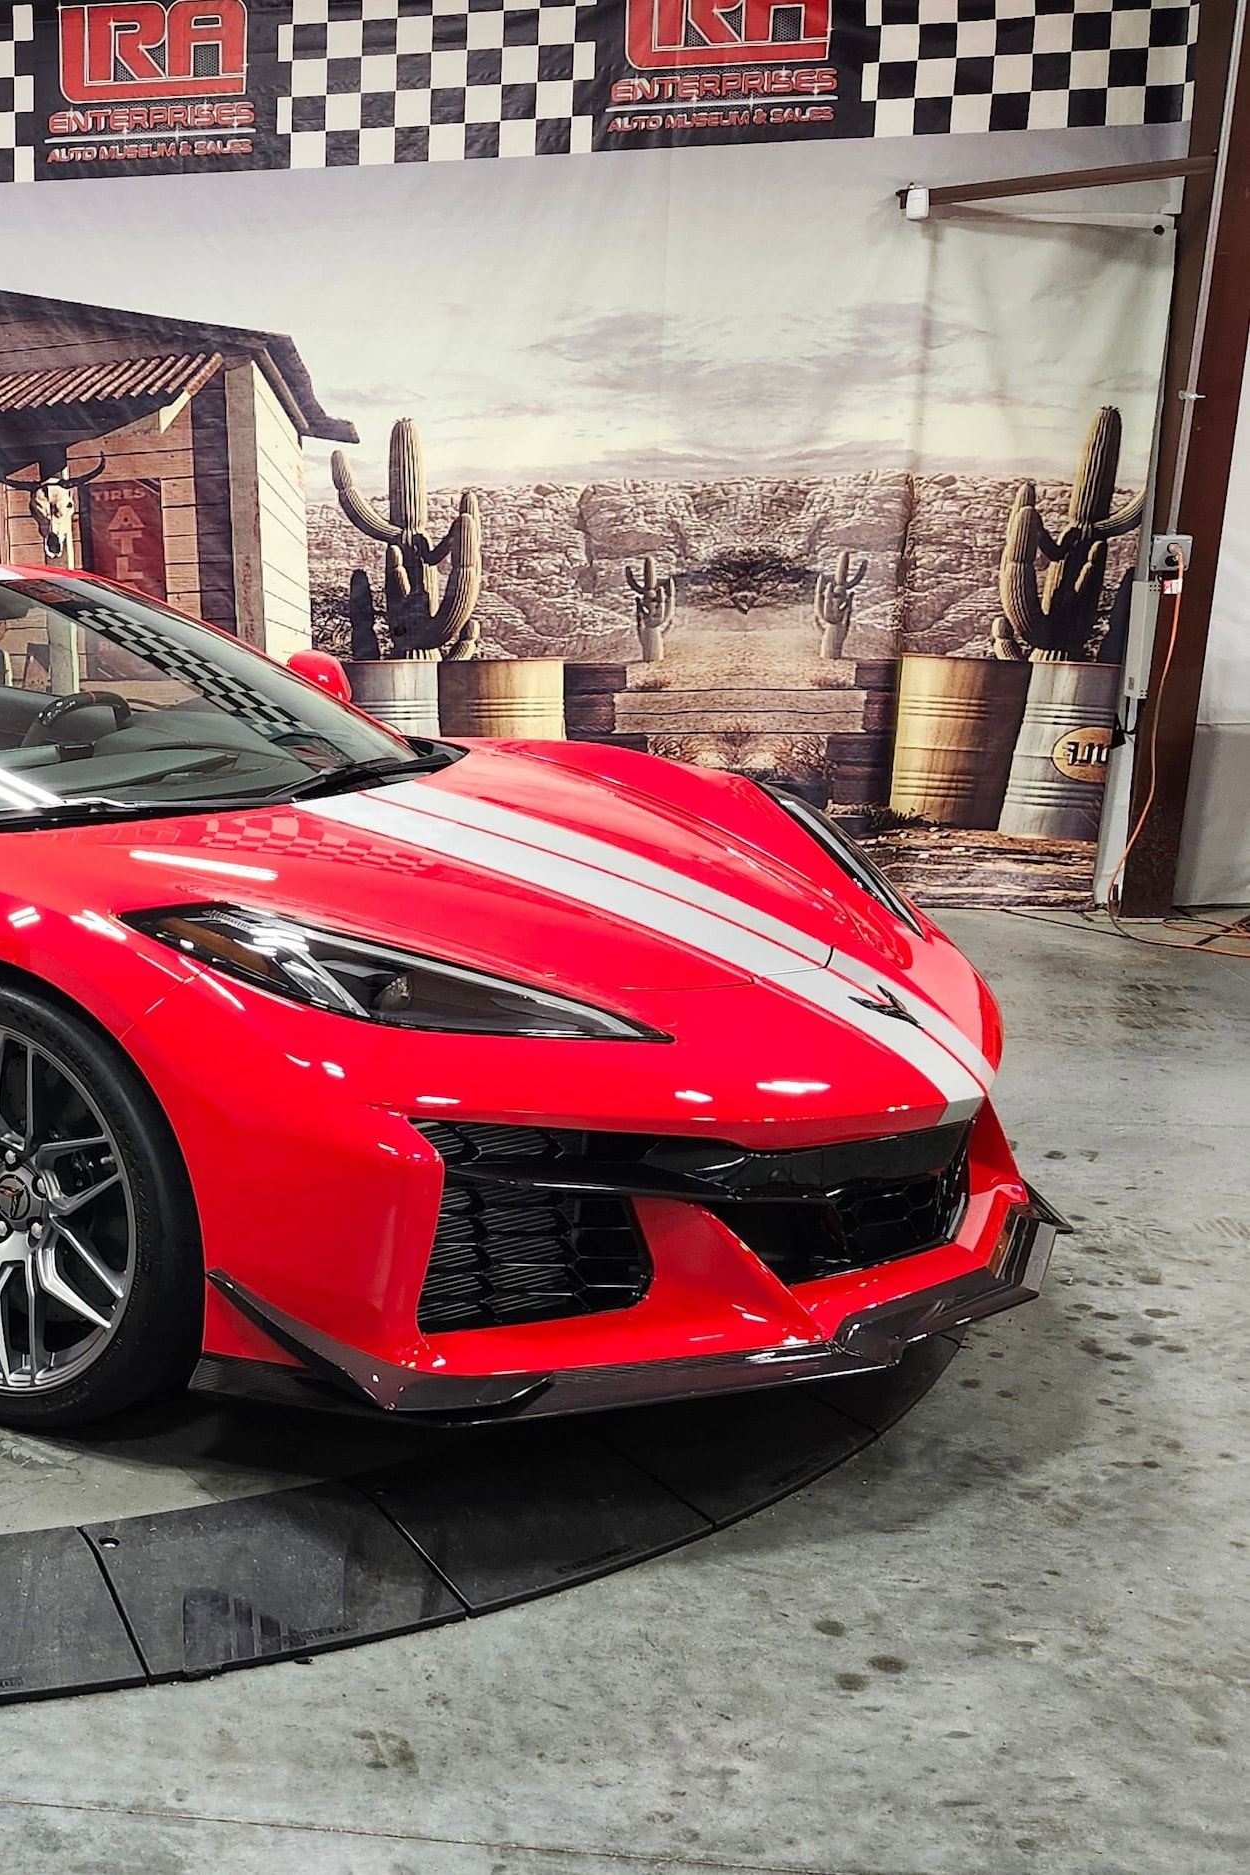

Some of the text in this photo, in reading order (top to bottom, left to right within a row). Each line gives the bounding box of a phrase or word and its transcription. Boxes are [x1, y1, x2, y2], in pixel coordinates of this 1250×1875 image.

[610, 68, 838, 103] ENTERPRISES
[48, 102, 256, 134] ENTERPRISES
[607, 106, 835, 133] AUTO MUSEUM & SALES
[46, 138, 254, 163] AUTO MUSEUM & SALES
[91, 487, 147, 501] TIRES
